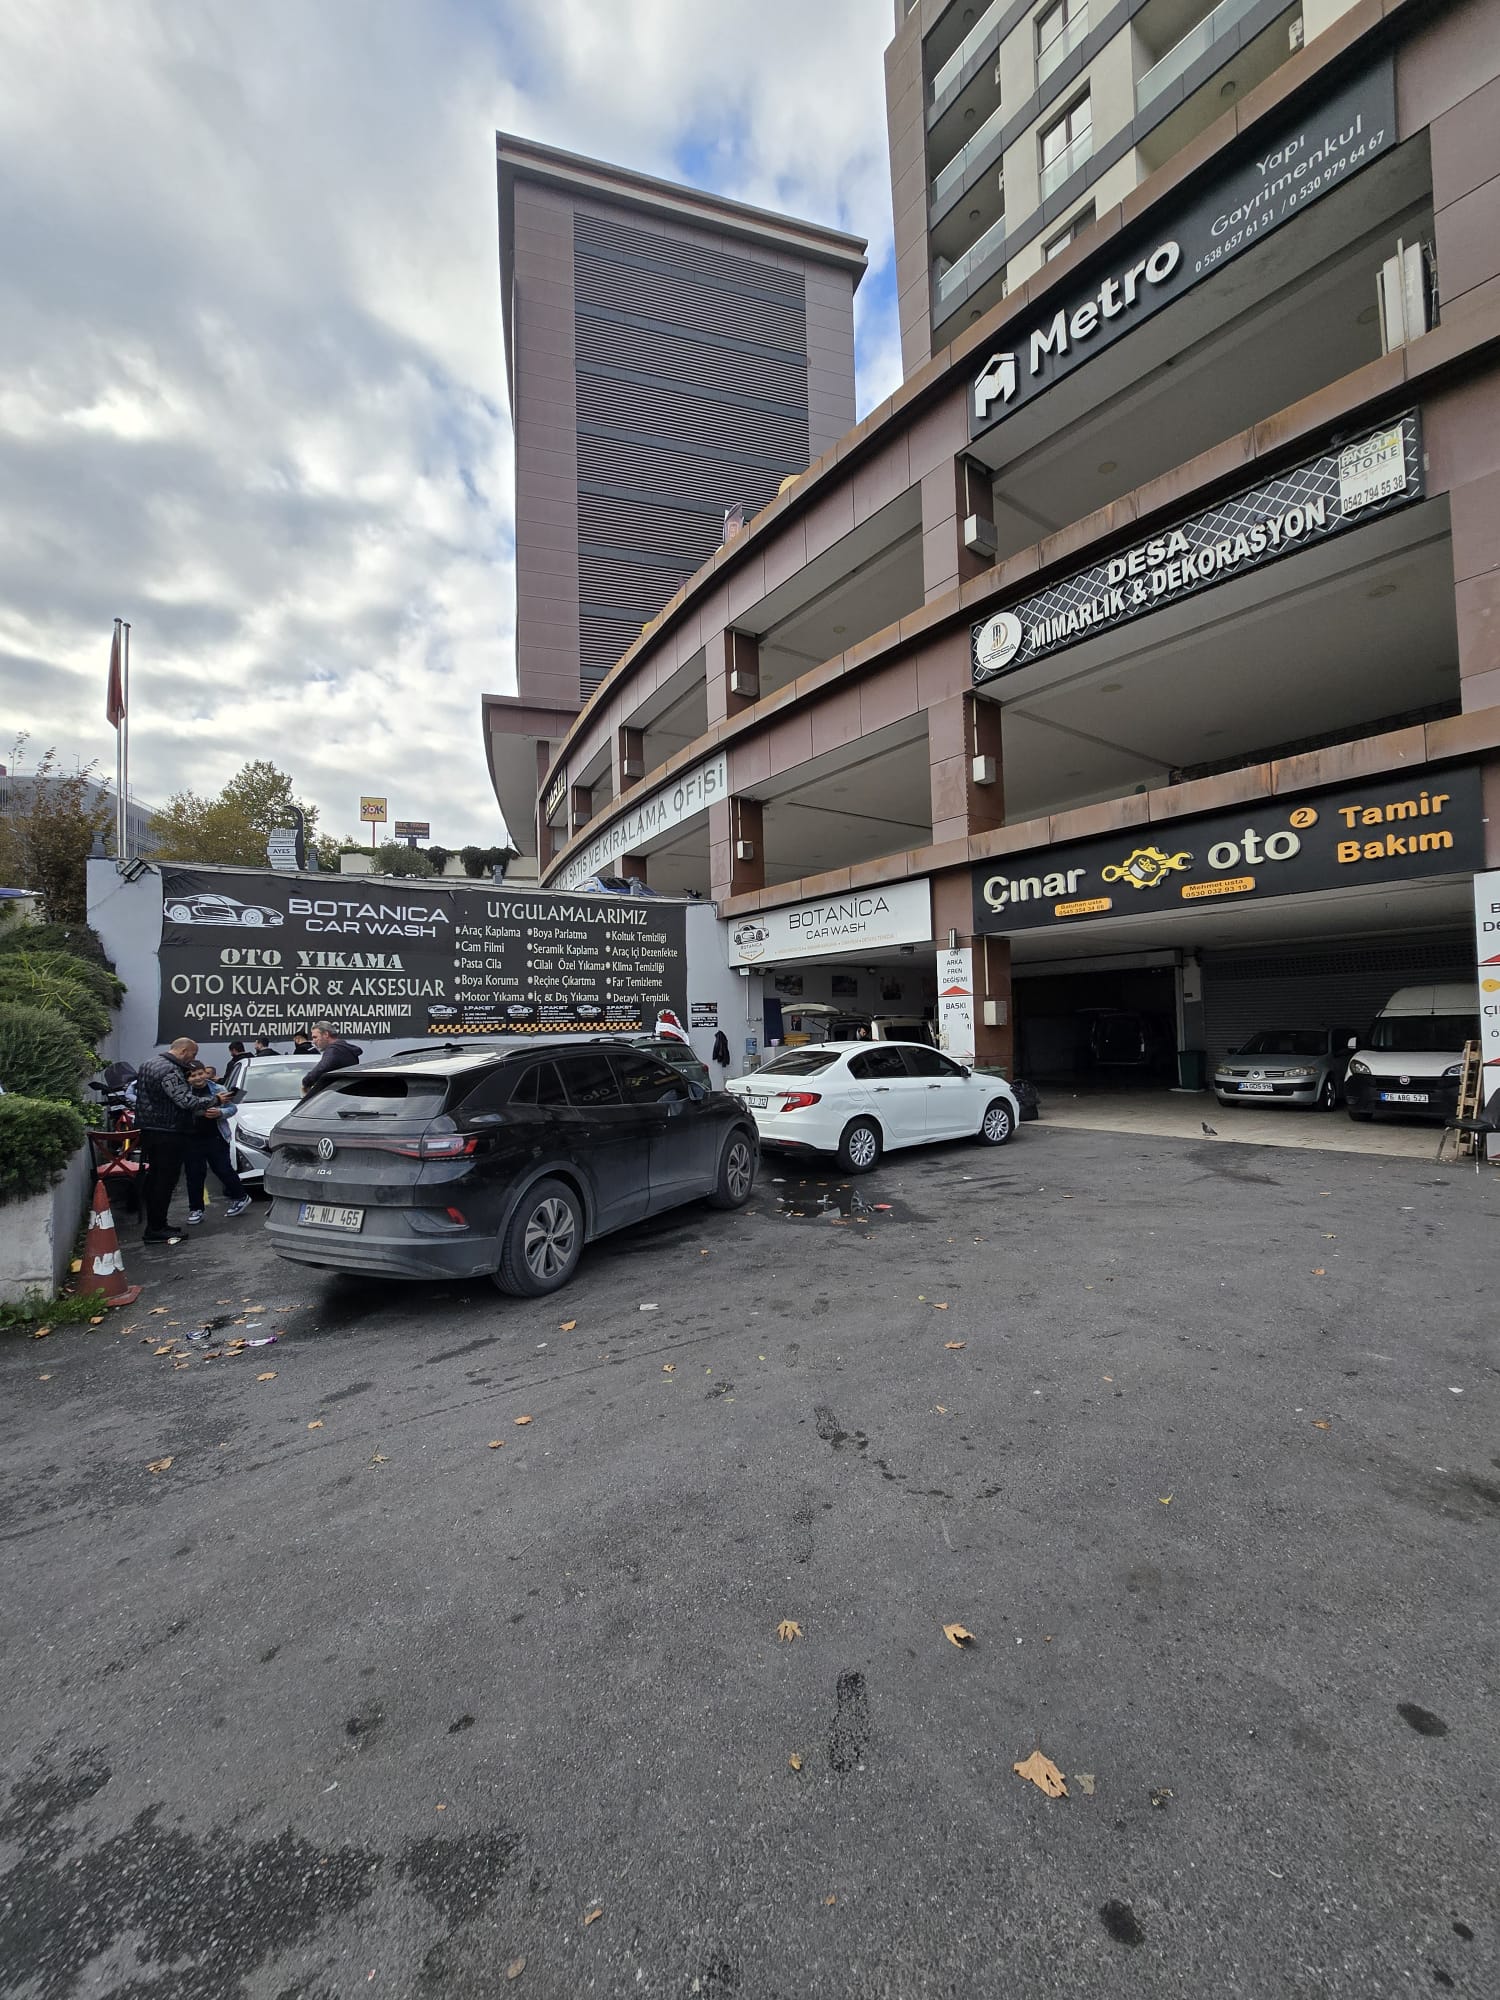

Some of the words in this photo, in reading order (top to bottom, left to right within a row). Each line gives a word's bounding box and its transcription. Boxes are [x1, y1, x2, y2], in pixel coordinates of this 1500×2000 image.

[1255, 135, 1305, 176] Yapı
[1211, 114, 1363, 237] Gayrimenkul
[1195, 261, 1201, 273] 0
[1204, 246, 1222, 267] 538
[1224, 230, 1243, 251] 657
[1246, 220, 1258, 237] 61
[1262, 209, 1274, 226] 51
[1300, 177, 1321, 199] 530
[1324, 158, 1346, 181] 979
[1350, 145, 1365, 164] 64
[1368, 129, 1385, 149] 67
[1030, 241, 1180, 375] Metro
[1343, 445, 1398, 479] STONE
[1343, 492, 1362, 511] 0542
[1364, 485, 1379, 503] 794
[1381, 480, 1391, 495] 55
[1393, 475, 1404, 490] 38
[1107, 529, 1190, 586] DESA
[1130, 575, 1148, 605] &
[1152, 496, 1326, 598] DEKORASYON
[673, 763, 723, 812] OFİSİ
[1337, 791, 1450, 829] Tamir
[1337, 829, 1454, 864] Bakım
[983, 867, 1087, 914] Çınar
[1207, 828, 1301, 870] oto
[289, 898, 449, 923] BOTANICA
[487, 901, 648, 925] UYGULAMALARIMIZ
[789, 896, 890, 930] BOTANİCA
[305, 919, 361, 934] CAR
[365, 922, 436, 938] WASH
[461, 925, 482, 938] Araç
[485, 925, 521, 938] Kaplama
[533, 928, 552, 940] Boya
[554, 928, 587, 940] Parlatma
[611, 930, 635, 942] Koltuk
[806, 928, 828, 940] CAR
[830, 922, 866, 936] WASH
[461, 941, 481, 952] Cam
[484, 941, 505, 953] Filmi
[533, 943, 564, 954] Seramik
[566, 944, 599, 957] Kaplama
[611, 946, 630, 958] Araç
[641, 947, 678, 958] Dezenfekte
[220, 948, 282, 966] OTO
[297, 950, 403, 969] YIKAMA
[461, 957, 483, 969] Pasta
[485, 958, 502, 969] Cila
[558, 958, 576, 970] Özel
[578, 960, 605, 971] Yıkama
[612, 961, 633, 972] Klima
[171, 974, 224, 995] OTO
[232, 972, 321, 996] KUAFÖR
[327, 980, 344, 996] &
[349, 977, 446, 998] AKSESUAR
[461, 974, 483, 987] Boya
[485, 974, 519, 986] Koruma
[533, 975, 560, 988] Reçine
[561, 976, 596, 988] Çıkartma
[612, 976, 624, 987] Far
[626, 976, 663, 987] Temizleme
[461, 991, 491, 1002] Motor
[493, 991, 525, 1002] Yıkama
[544, 993, 553, 1002] &
[555, 992, 568, 1004] Dış
[570, 991, 599, 1002] Yıkama
[613, 993, 639, 1004] Detaylı
[640, 993, 671, 1002] Temizlik
[184, 1003, 243, 1021] AÇILIŞA
[246, 1001, 283, 1018] ÖZEL
[287, 1004, 412, 1018] KAMPANYALARIMIZI
[210, 1020, 309, 1036] FİYATLARIMIZI
[305, 1206, 315, 1222] 34
[340, 1210, 360, 1226] 465
